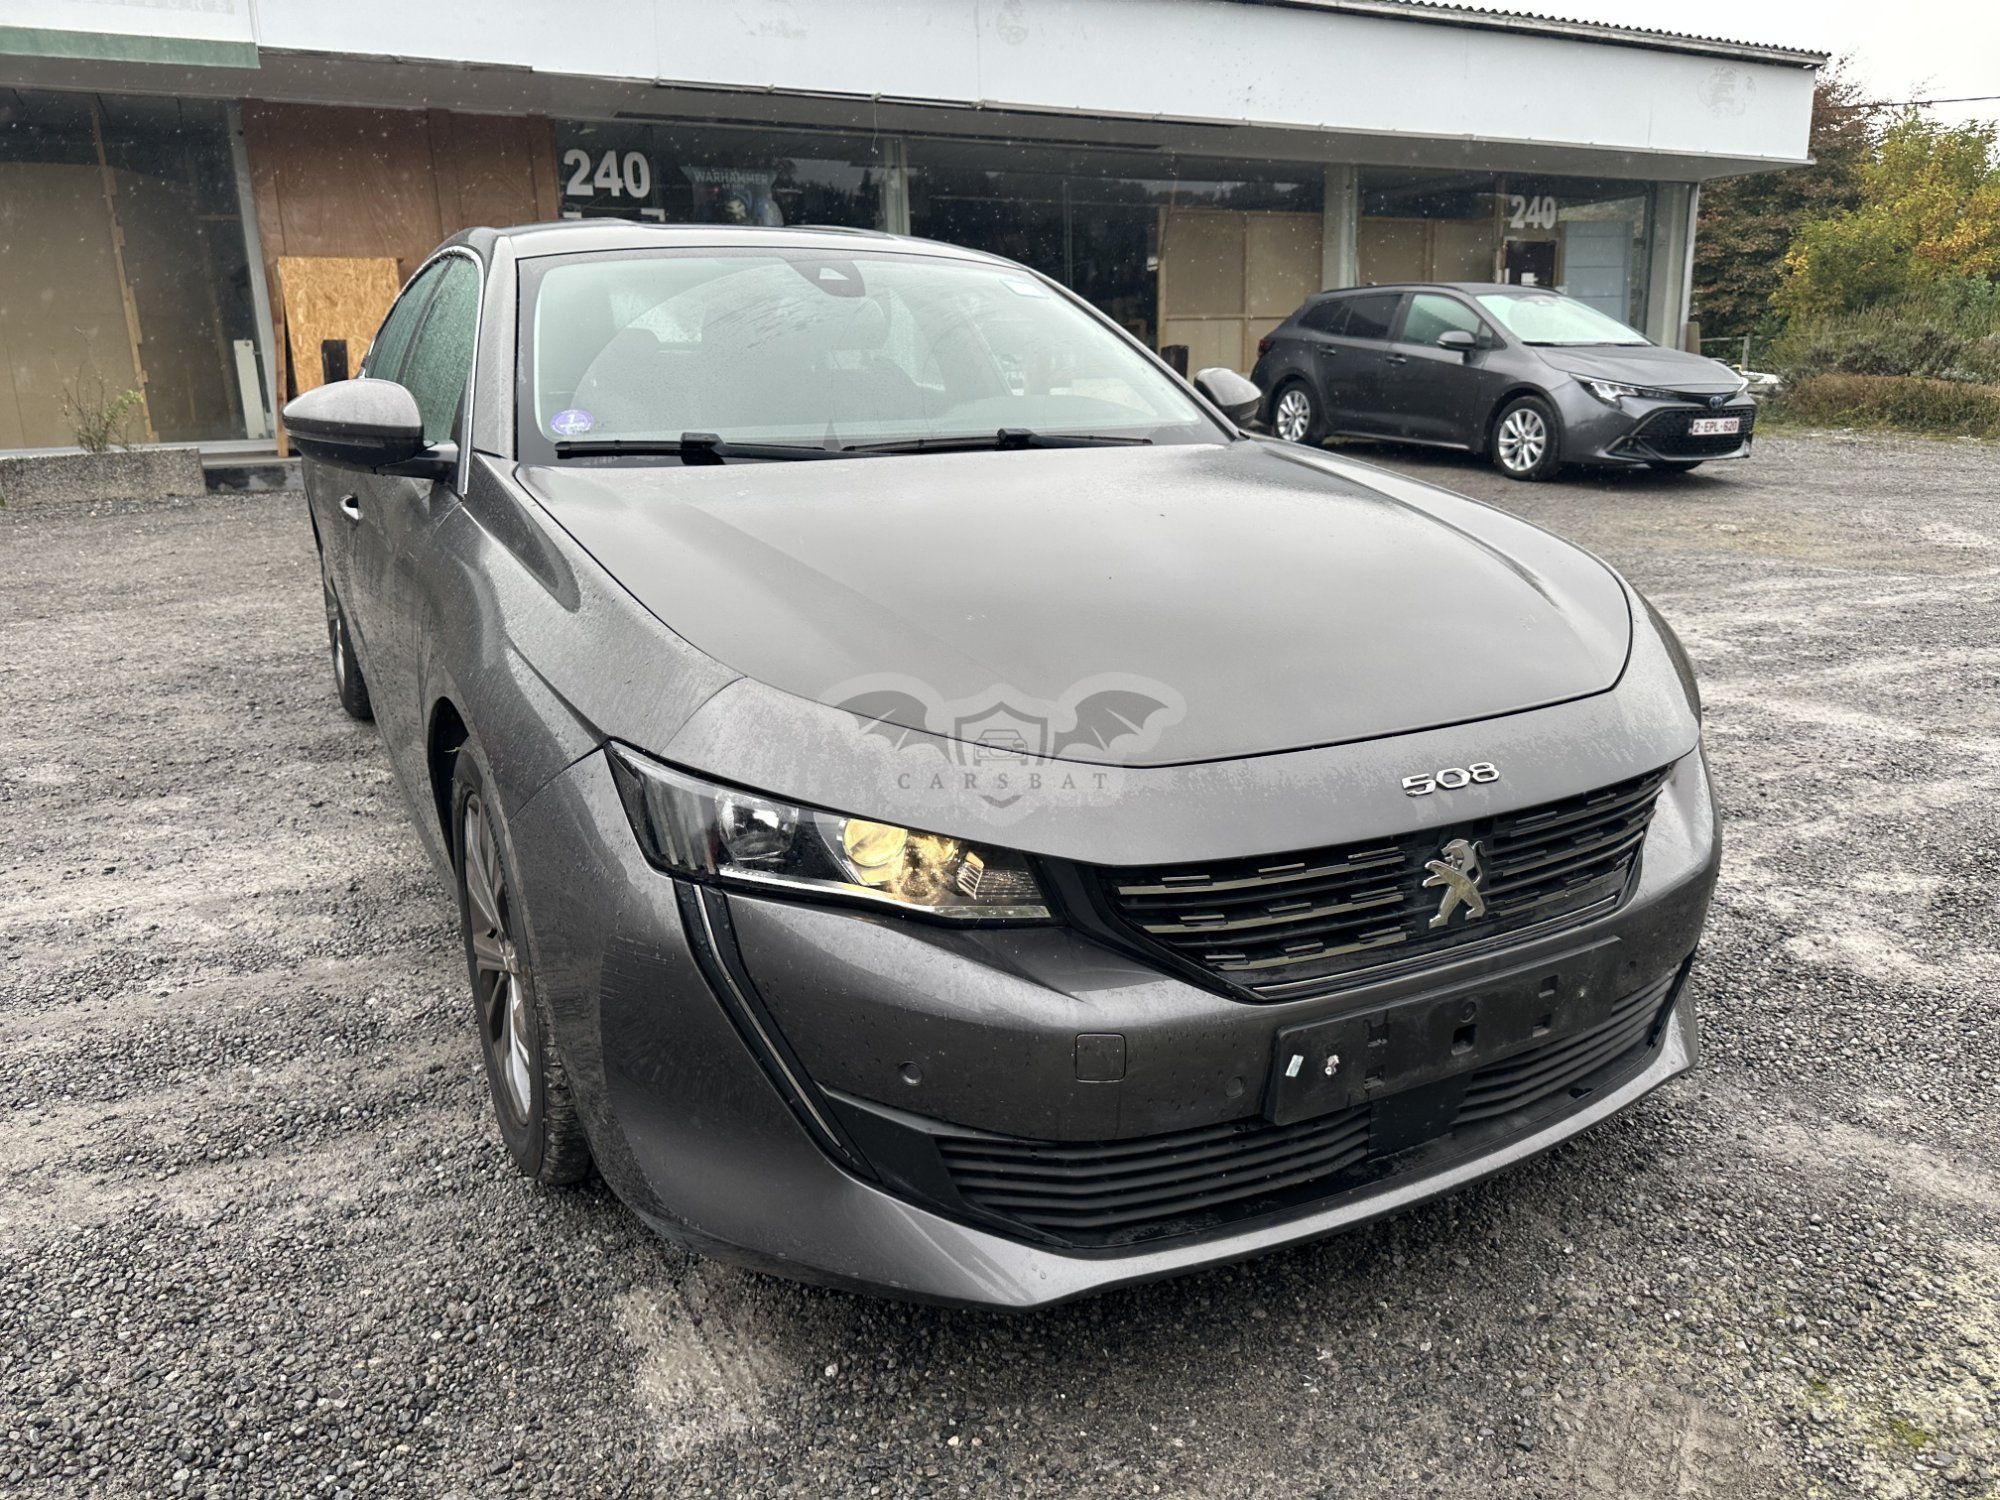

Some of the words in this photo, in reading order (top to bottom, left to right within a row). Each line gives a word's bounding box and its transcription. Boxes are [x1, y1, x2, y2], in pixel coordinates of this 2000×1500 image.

[563, 148, 651, 199] 240
[693, 170, 768, 185] WARHAMMER
[1510, 194, 1556, 230] 240
[1401, 762, 1500, 797] 508
